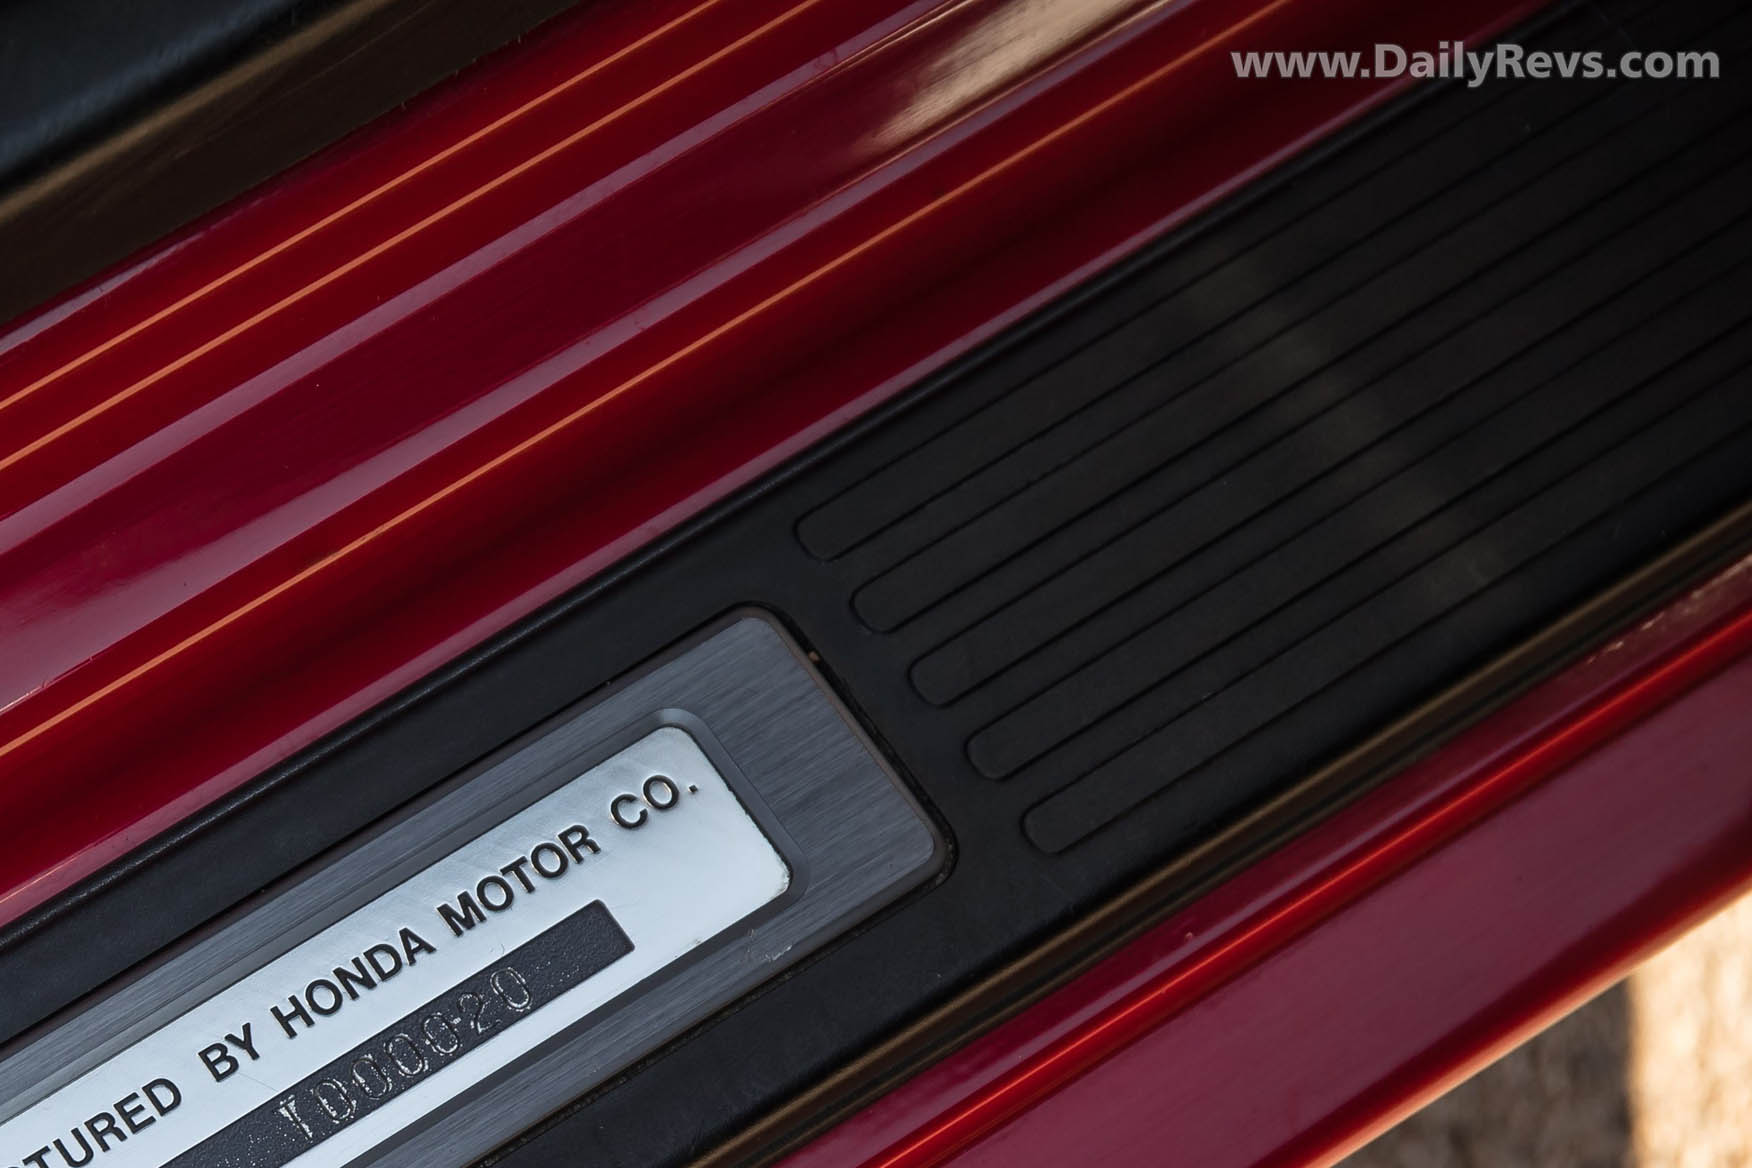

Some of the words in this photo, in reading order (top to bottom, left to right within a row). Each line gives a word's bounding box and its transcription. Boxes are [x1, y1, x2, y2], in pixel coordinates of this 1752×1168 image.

[198, 1023, 260, 1082] BY
[271, 928, 436, 1039] HONDA
[437, 825, 601, 937] MOTOR
[611, 775, 699, 831] CO.
